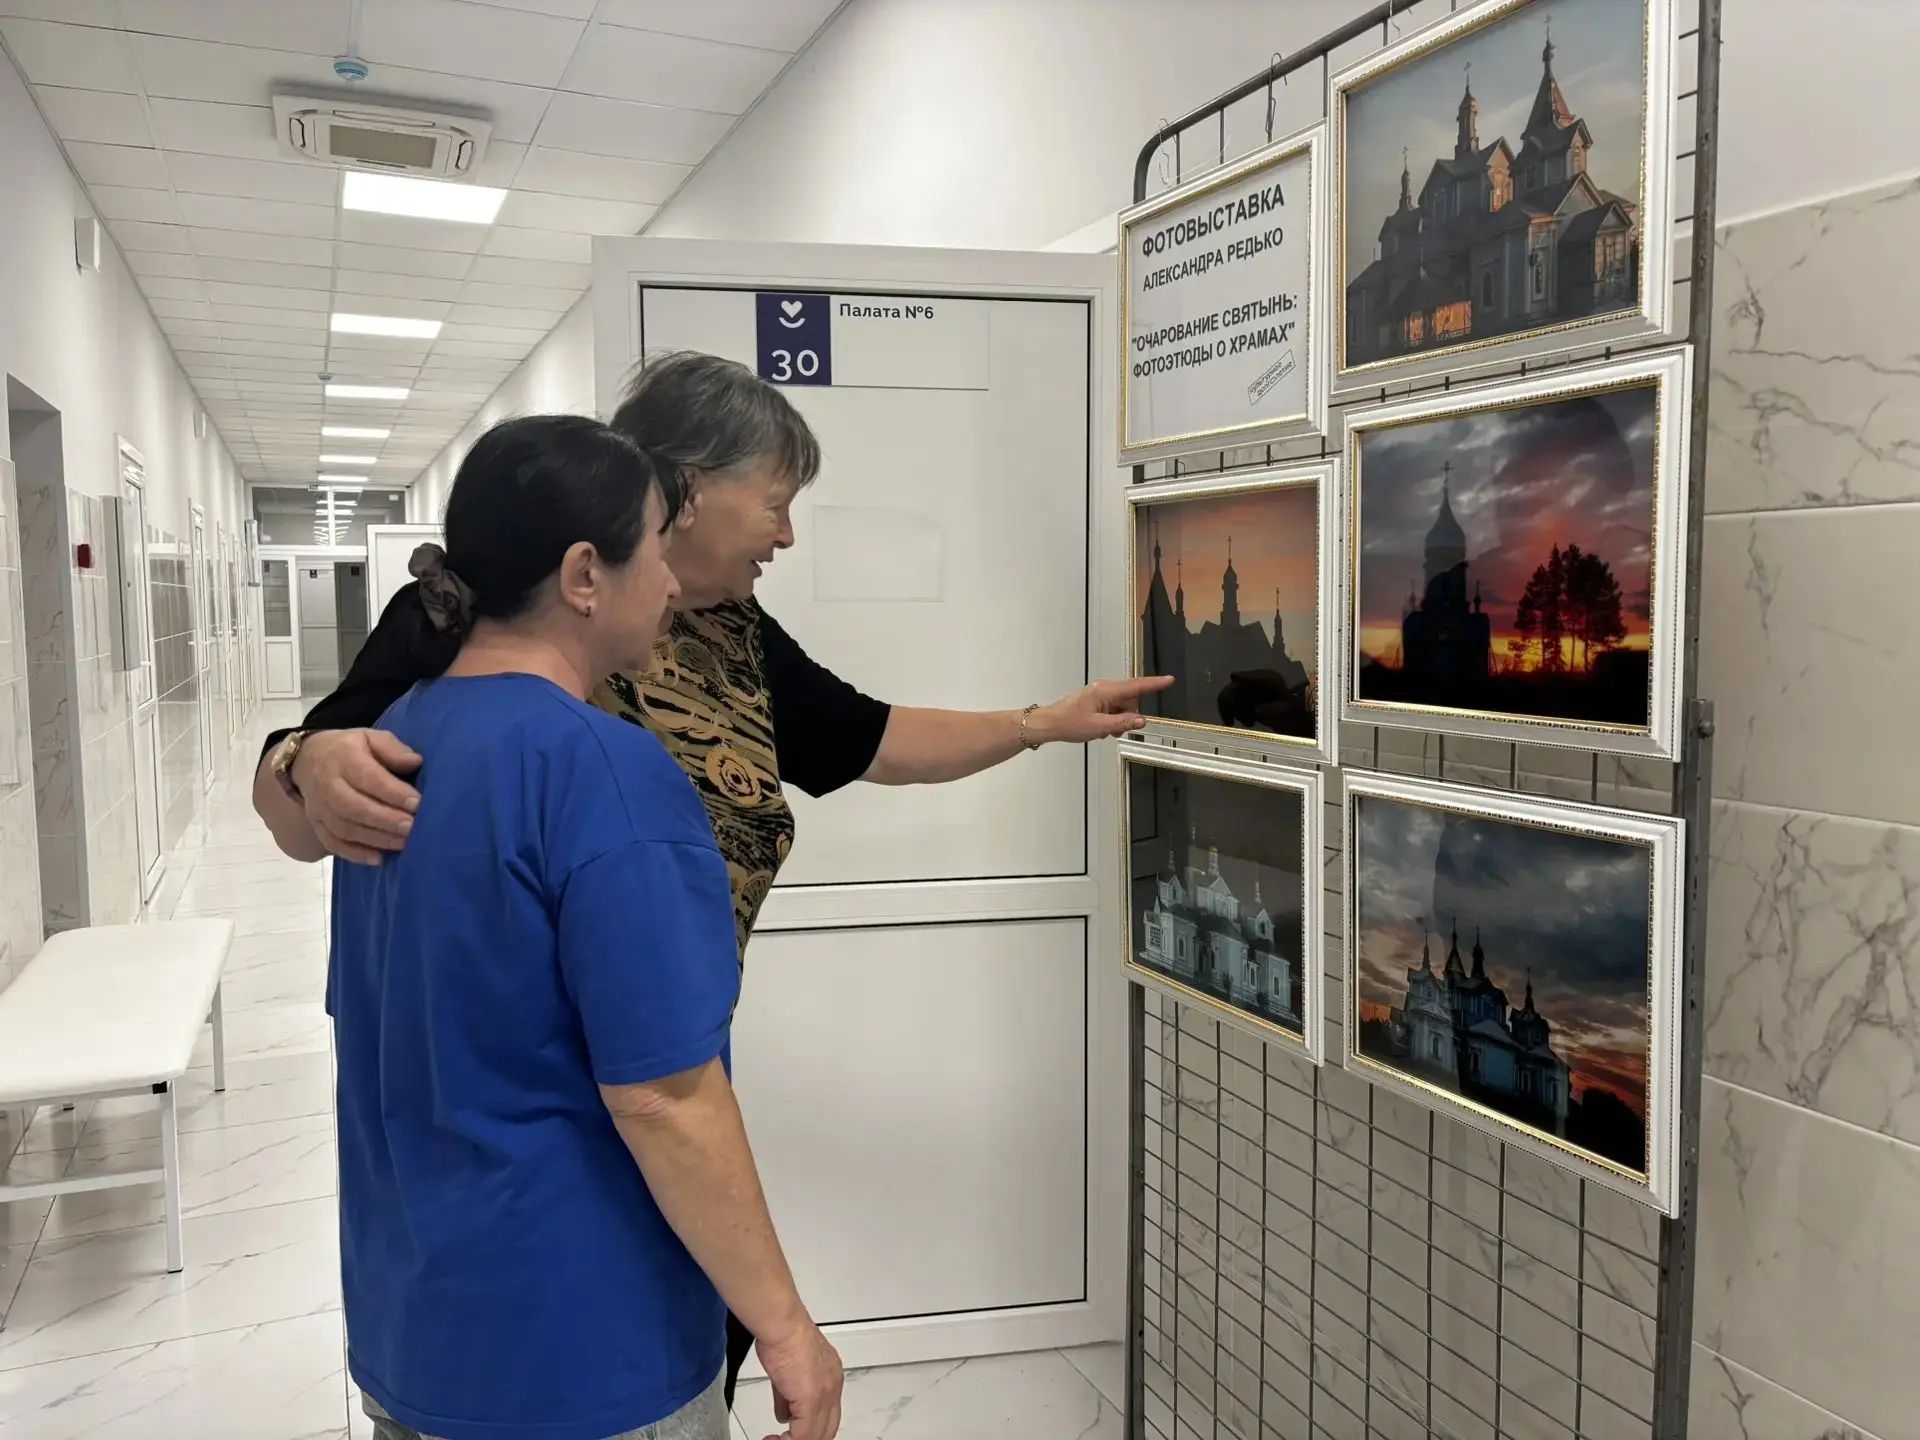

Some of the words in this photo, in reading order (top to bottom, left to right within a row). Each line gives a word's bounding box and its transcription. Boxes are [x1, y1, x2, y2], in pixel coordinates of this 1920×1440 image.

[1142, 183, 1285, 258] ФОТОВЫСТАВКА
[1142, 248, 1224, 292] АЛЕКСАНДРА
[1227, 227, 1284, 263] РЕДЬКО
[839, 303, 901, 319] Палата
[905, 305, 934, 320] №6
[1131, 313, 1219, 352] "ОЧАРОВАНИЕ
[1222, 293, 1298, 328] СВЯТЫНЬ:
[771, 349, 819, 382] 30
[1133, 343, 1213, 378] ФОТОЭТЮДЫ
[1216, 339, 1226, 357] О
[1229, 321, 1295, 356] ХРАМАХ"
